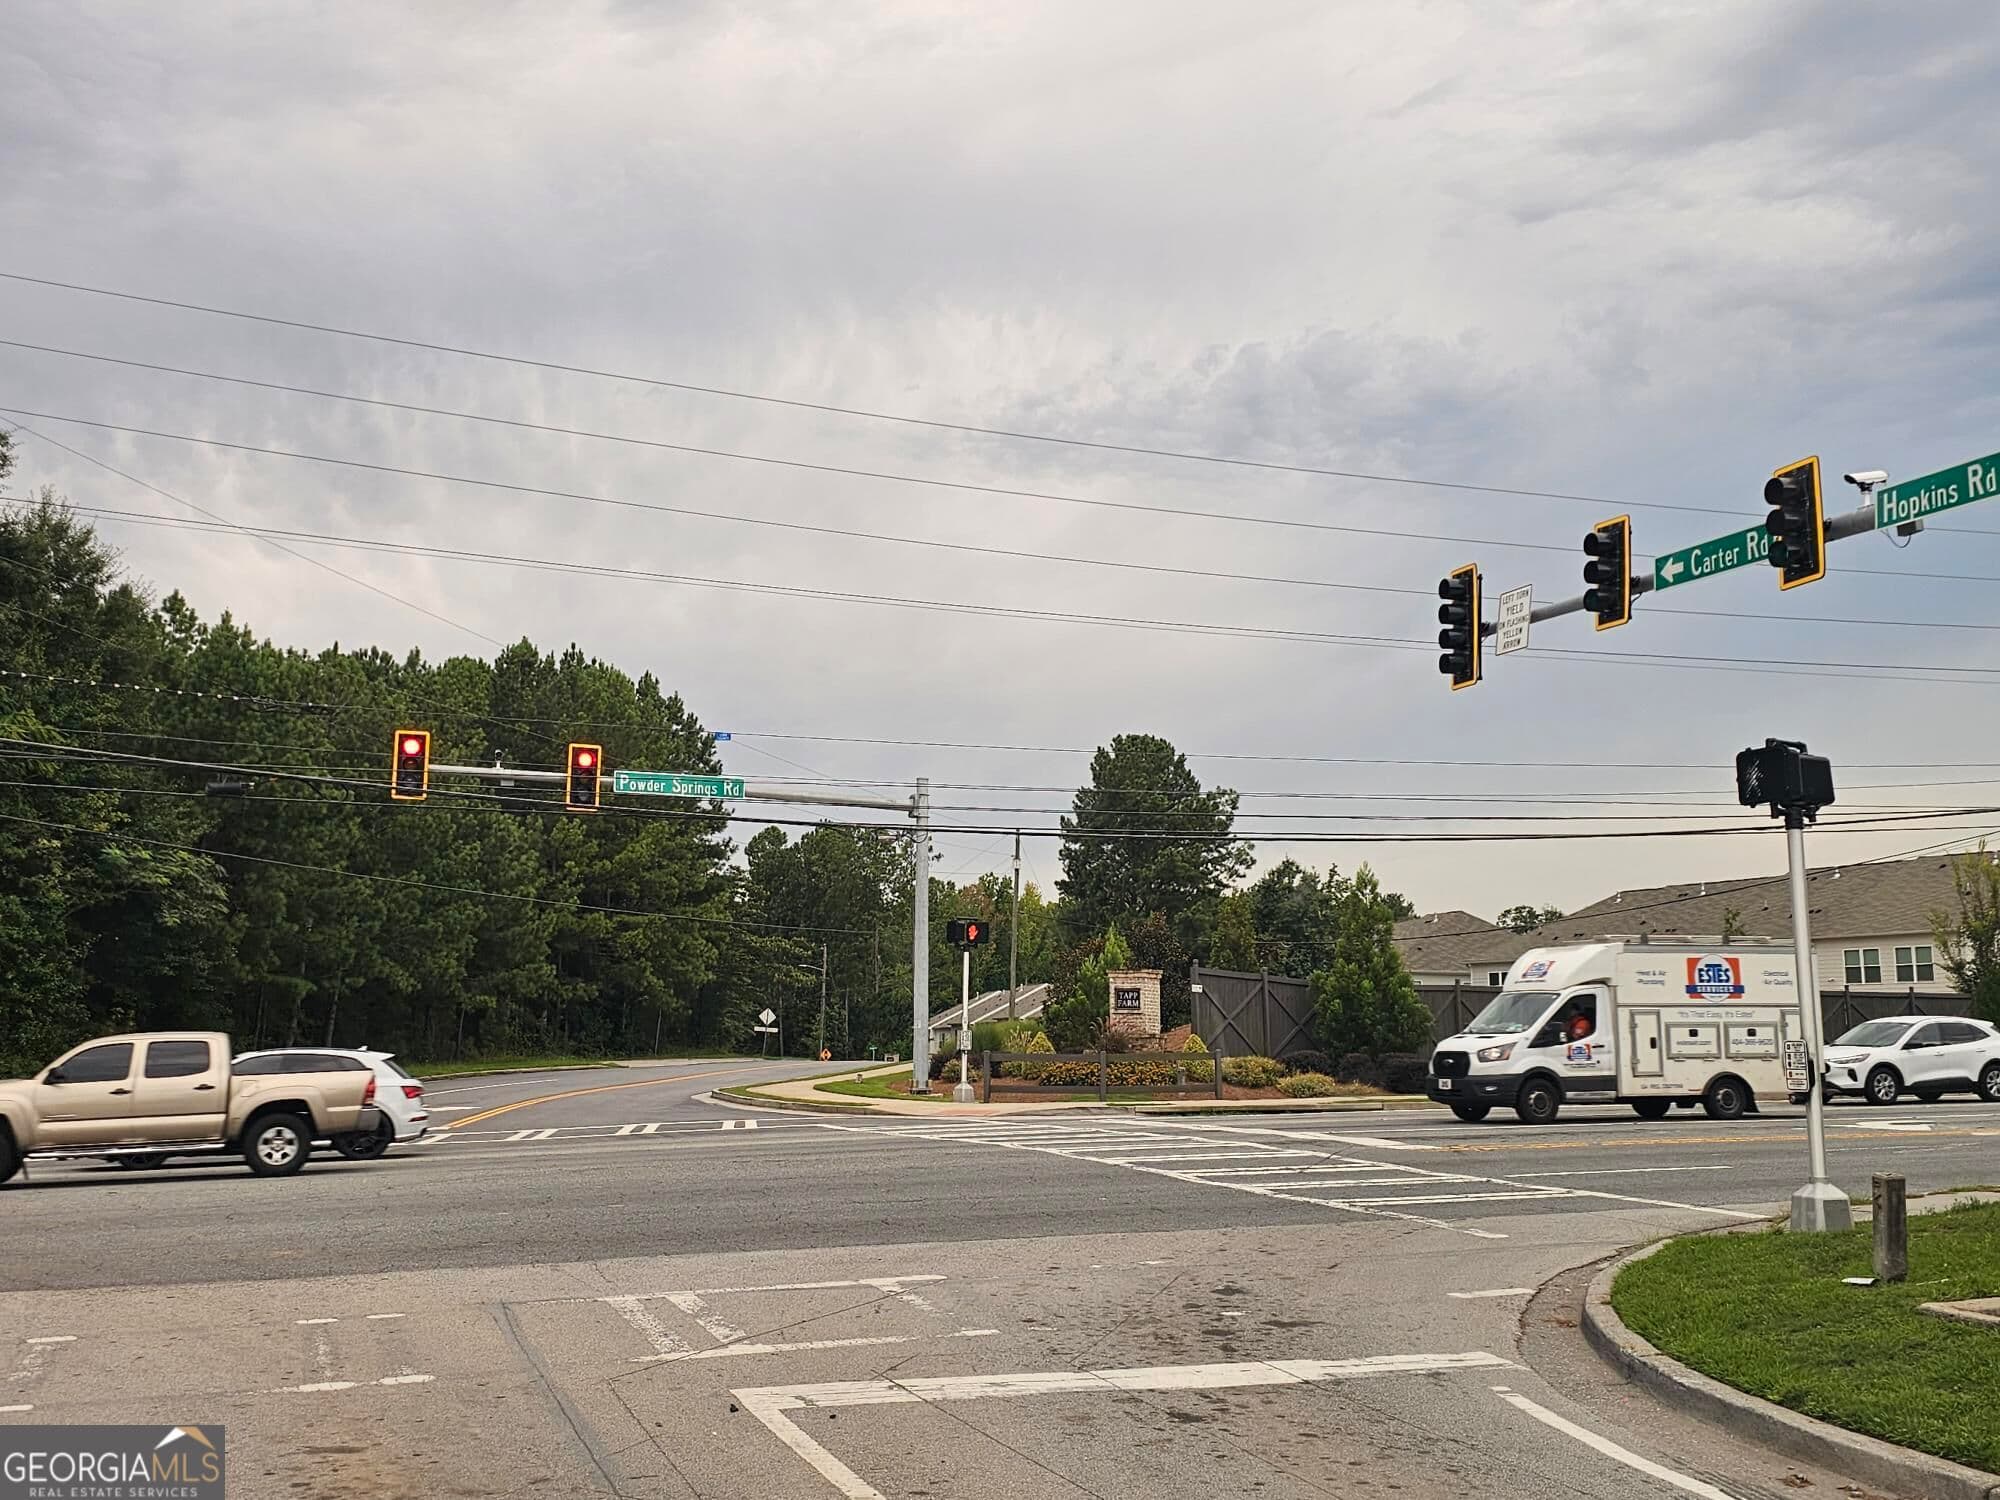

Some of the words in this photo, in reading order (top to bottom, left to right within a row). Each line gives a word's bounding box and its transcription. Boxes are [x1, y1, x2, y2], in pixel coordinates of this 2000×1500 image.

[1883, 484, 1958, 523] Hopkins
[1967, 463, 1997, 498] Rd
[1691, 547, 1740, 576] Carter
[1746, 531, 1769, 560] Rd
[1503, 594, 1514, 605] LEFT
[1506, 602, 1523, 616] YIELD
[619, 774, 666, 791] Powder
[672, 777, 718, 797] Springs
[723, 780, 739, 796] Rd
[1697, 963, 1730, 984] ESTES
[1119, 991, 1138, 999] TAPP
